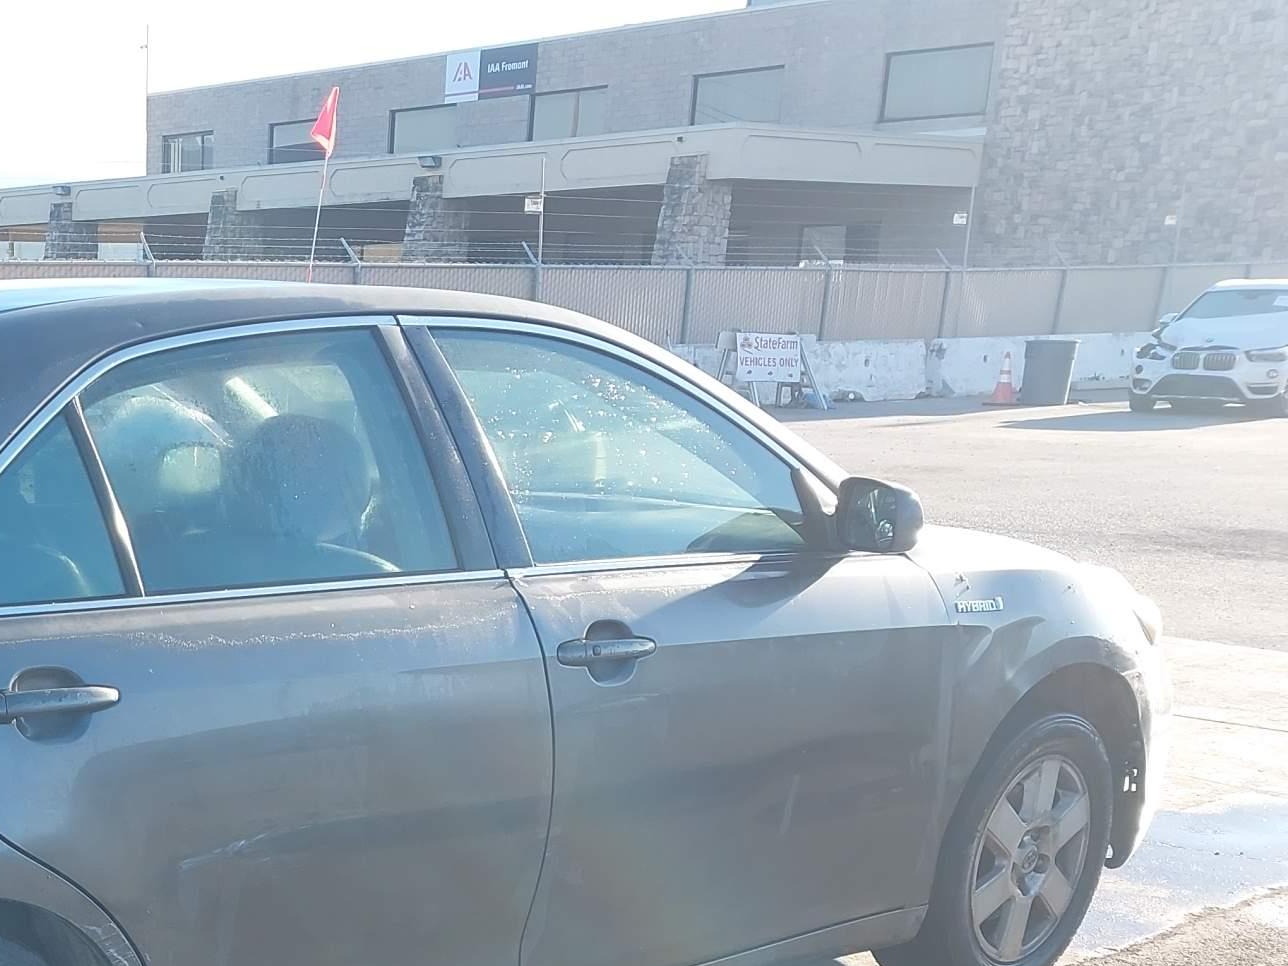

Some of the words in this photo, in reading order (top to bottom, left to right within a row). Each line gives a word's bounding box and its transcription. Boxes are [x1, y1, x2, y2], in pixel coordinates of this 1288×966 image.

[487, 62, 500, 73] IAA
[754, 336, 798, 351] StateFarm
[740, 356, 777, 368] VEHICLES
[779, 357, 799, 368] ONLY
[955, 599, 997, 613] HYBRID
